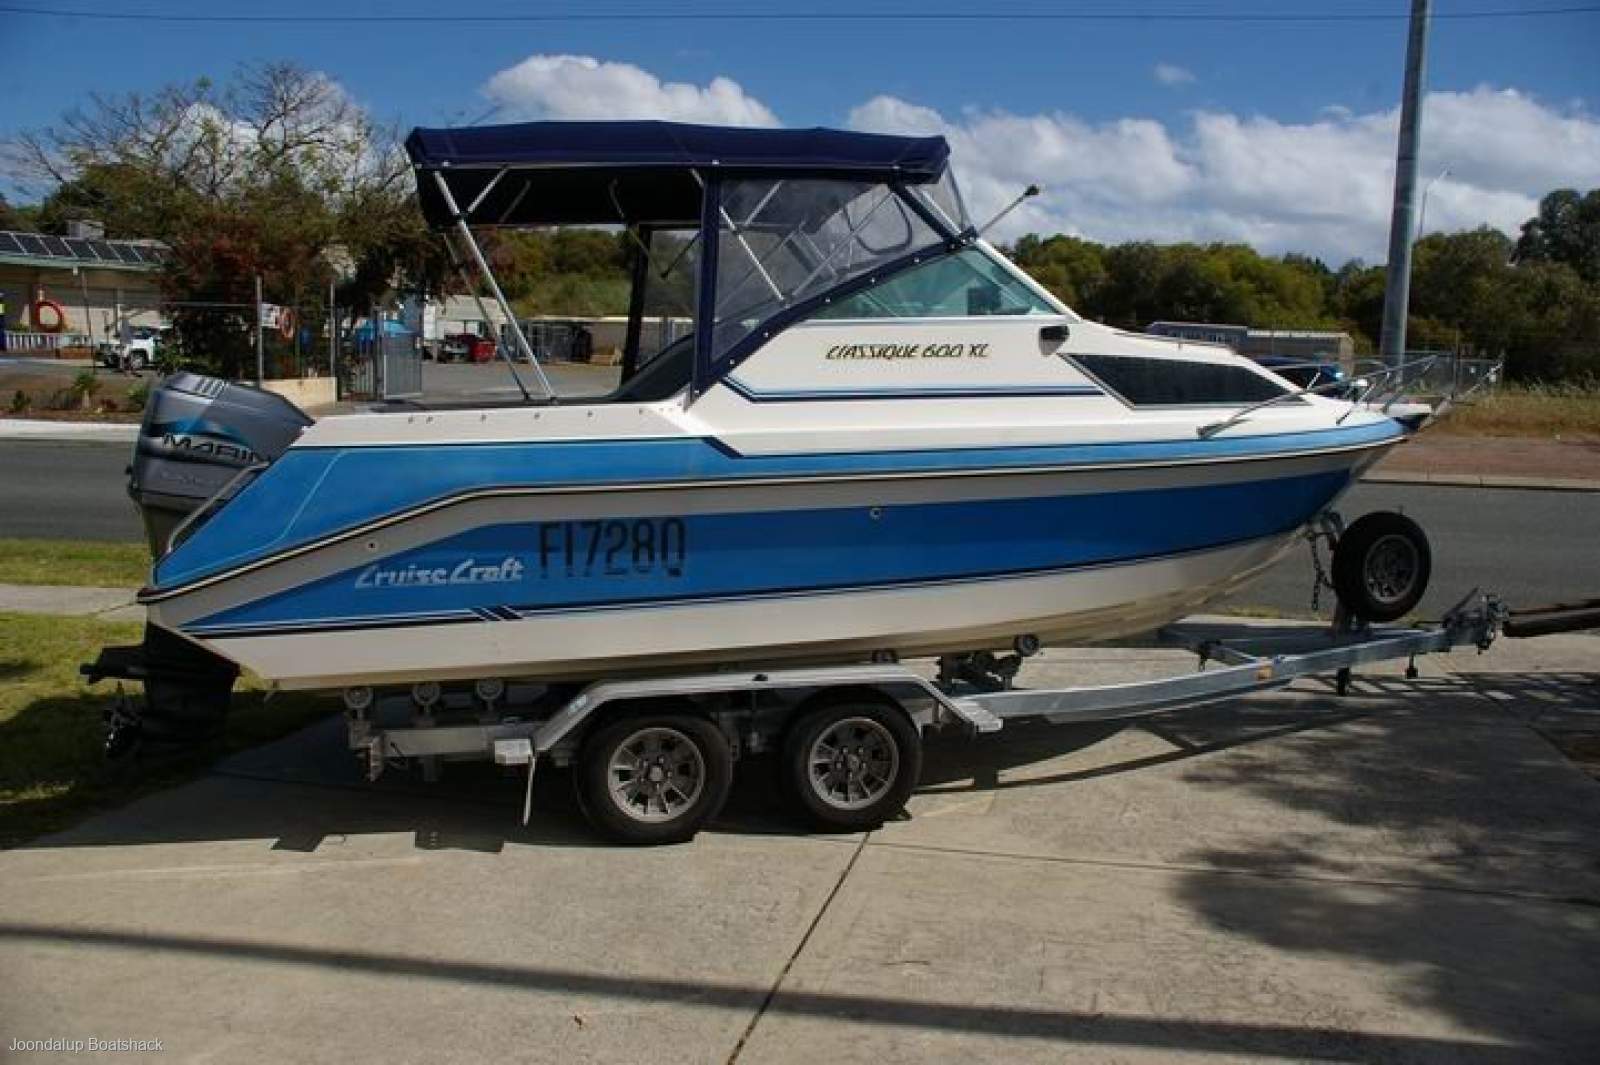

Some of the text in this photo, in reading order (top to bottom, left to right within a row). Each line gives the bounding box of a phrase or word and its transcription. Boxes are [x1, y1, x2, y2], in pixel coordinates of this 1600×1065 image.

[921, 343, 964, 358] 600
[966, 343, 990, 358] XL
[540, 517, 686, 579] FI728Q
